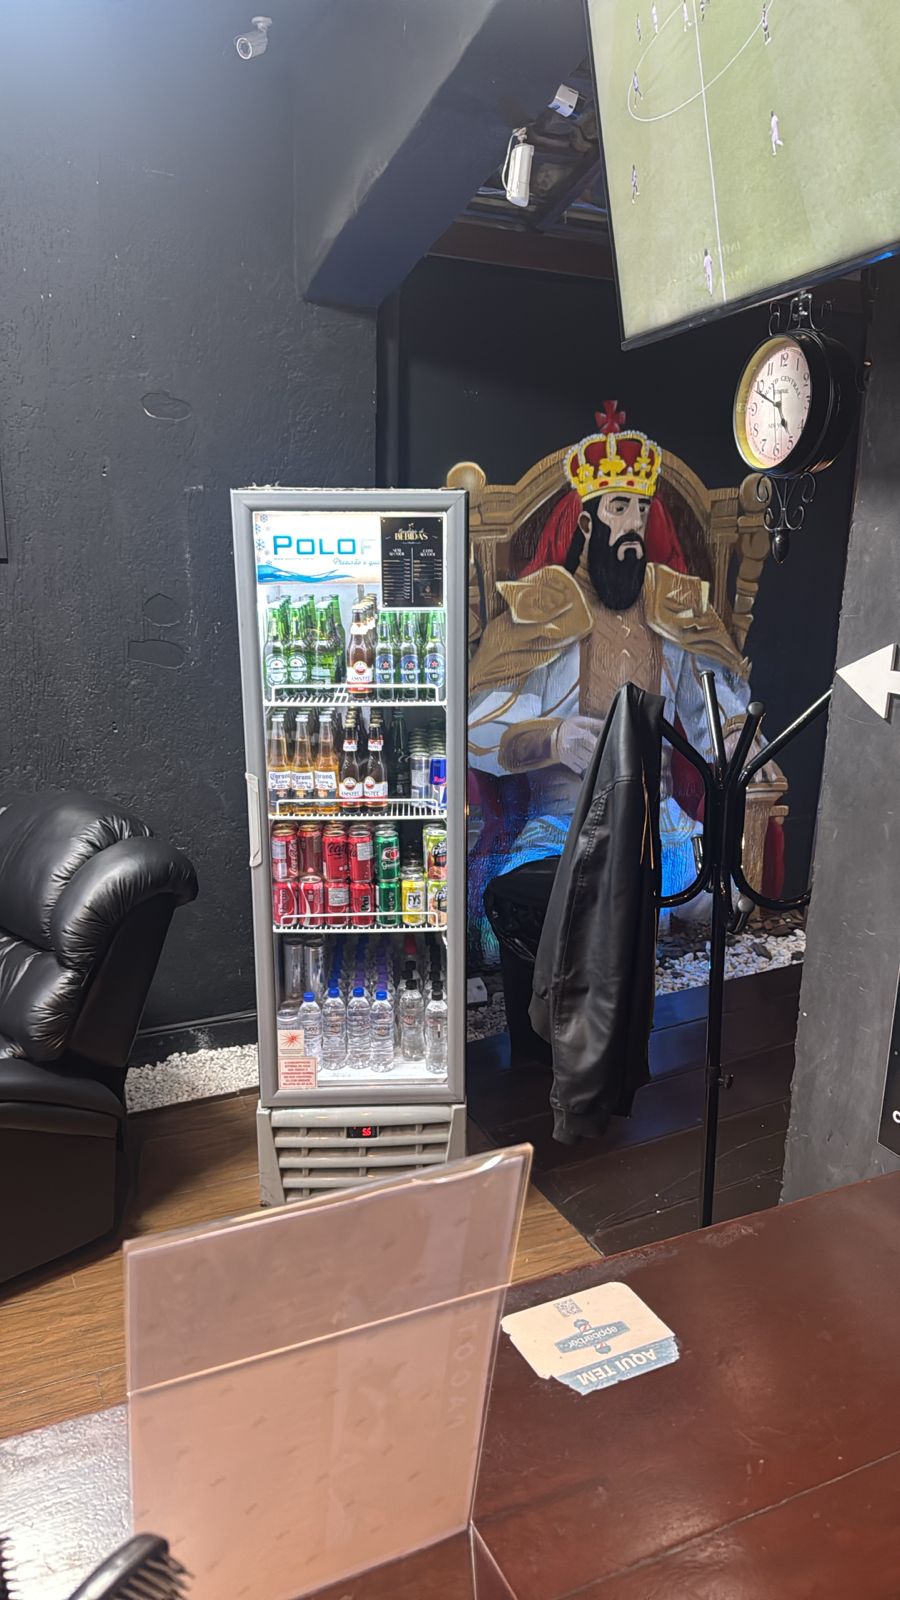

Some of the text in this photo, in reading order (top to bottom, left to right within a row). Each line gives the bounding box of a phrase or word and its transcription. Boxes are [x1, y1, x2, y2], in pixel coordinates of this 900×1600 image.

[752, 422, 759, 438] 8
[760, 438, 767, 453] 7
[408, 894, 421, 906] FYS
[576, 1348, 657, 1387] AQUI TEM
